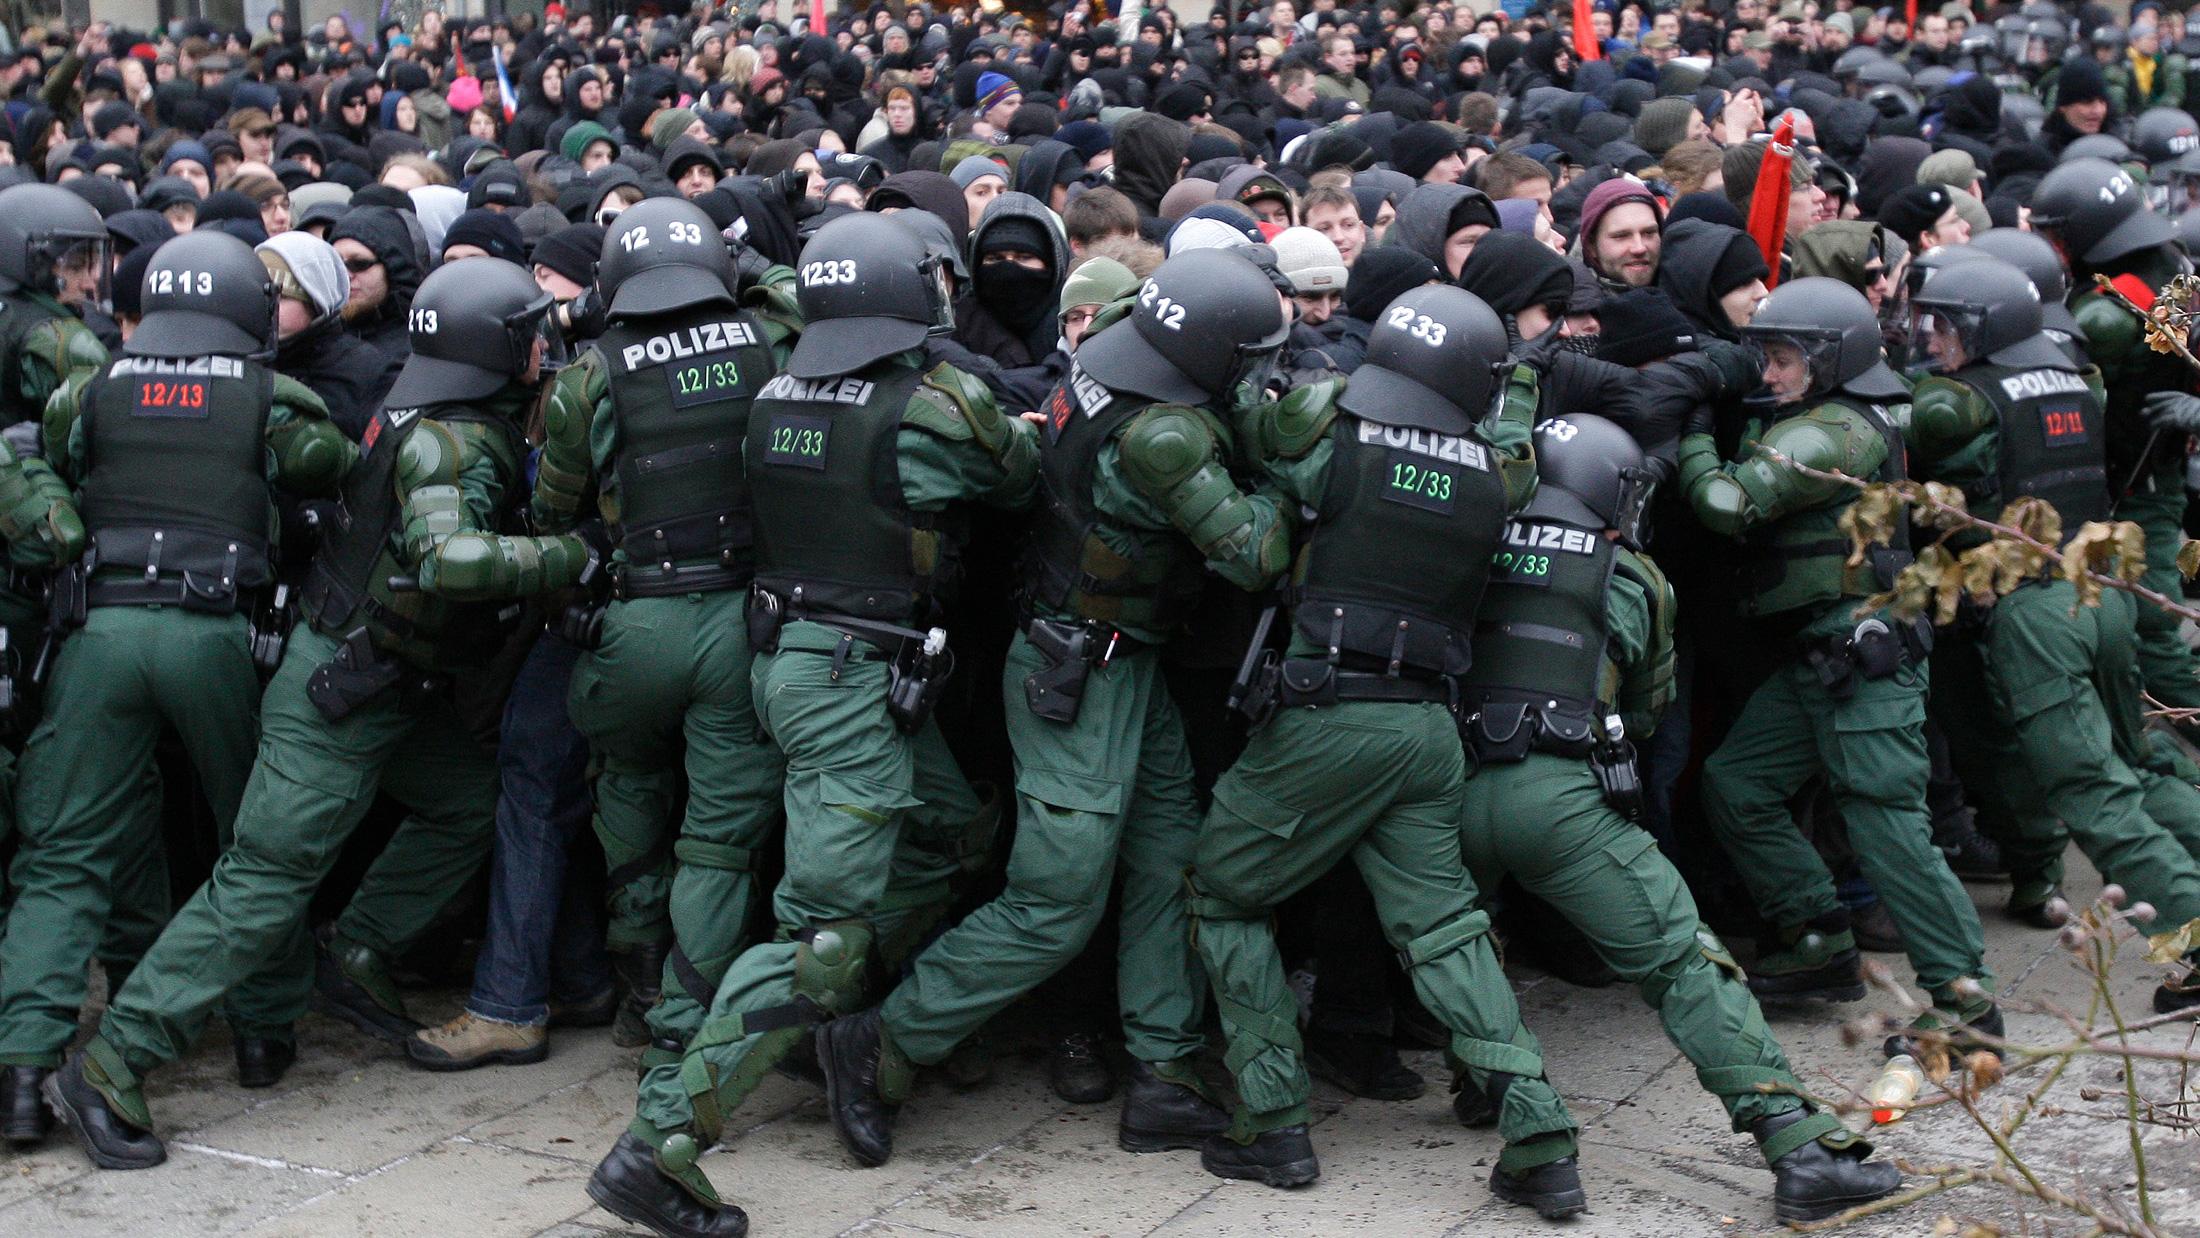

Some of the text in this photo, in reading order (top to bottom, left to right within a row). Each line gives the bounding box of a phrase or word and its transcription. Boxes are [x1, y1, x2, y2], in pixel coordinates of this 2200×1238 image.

[620, 221, 701, 252] 12 33
[149, 270, 212, 296] 1213
[801, 260, 856, 287] 1233
[1388, 306, 1447, 347] 1233
[623, 322, 758, 371] POLIZEI
[676, 361, 739, 393] 12/33
[141, 383, 204, 407] 12/13
[771, 427, 823, 457] 12/33
[1359, 420, 1489, 472] POLIZEI
[1391, 463, 1452, 499] 12/33
[1501, 521, 1596, 555] LIZEI
